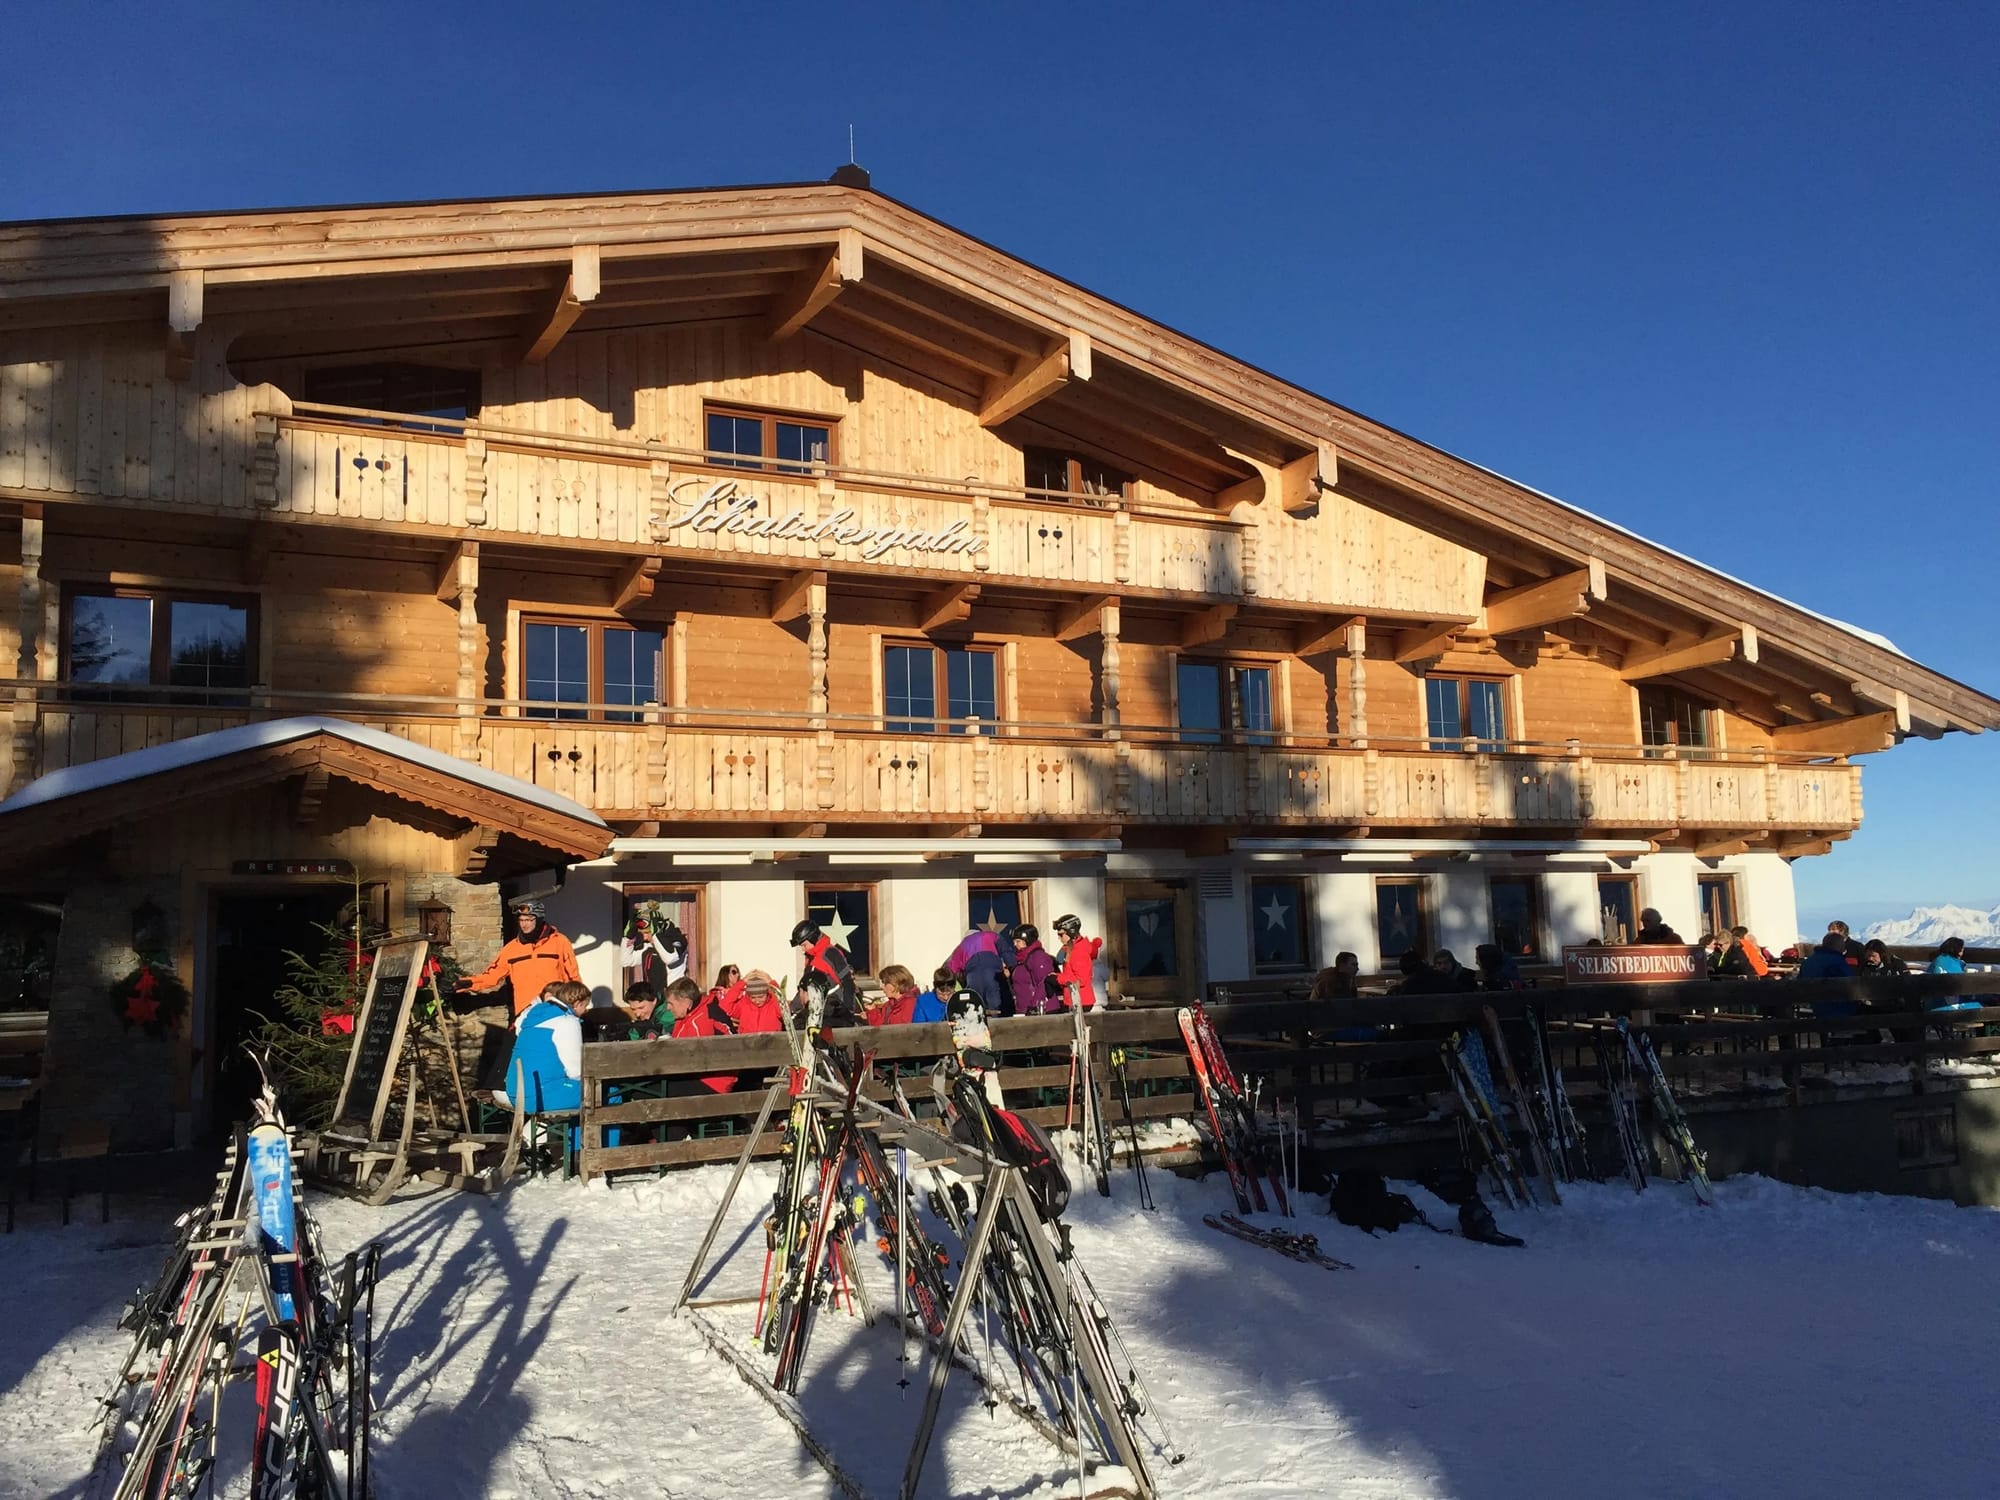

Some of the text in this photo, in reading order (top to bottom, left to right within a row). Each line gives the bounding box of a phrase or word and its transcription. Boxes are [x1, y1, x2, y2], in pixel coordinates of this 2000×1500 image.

[648, 477, 988, 560] Schatzbergalm
[1578, 954, 1695, 975] SELBSTBEDIENUNG
[275, 1234, 292, 1303] SALOON
